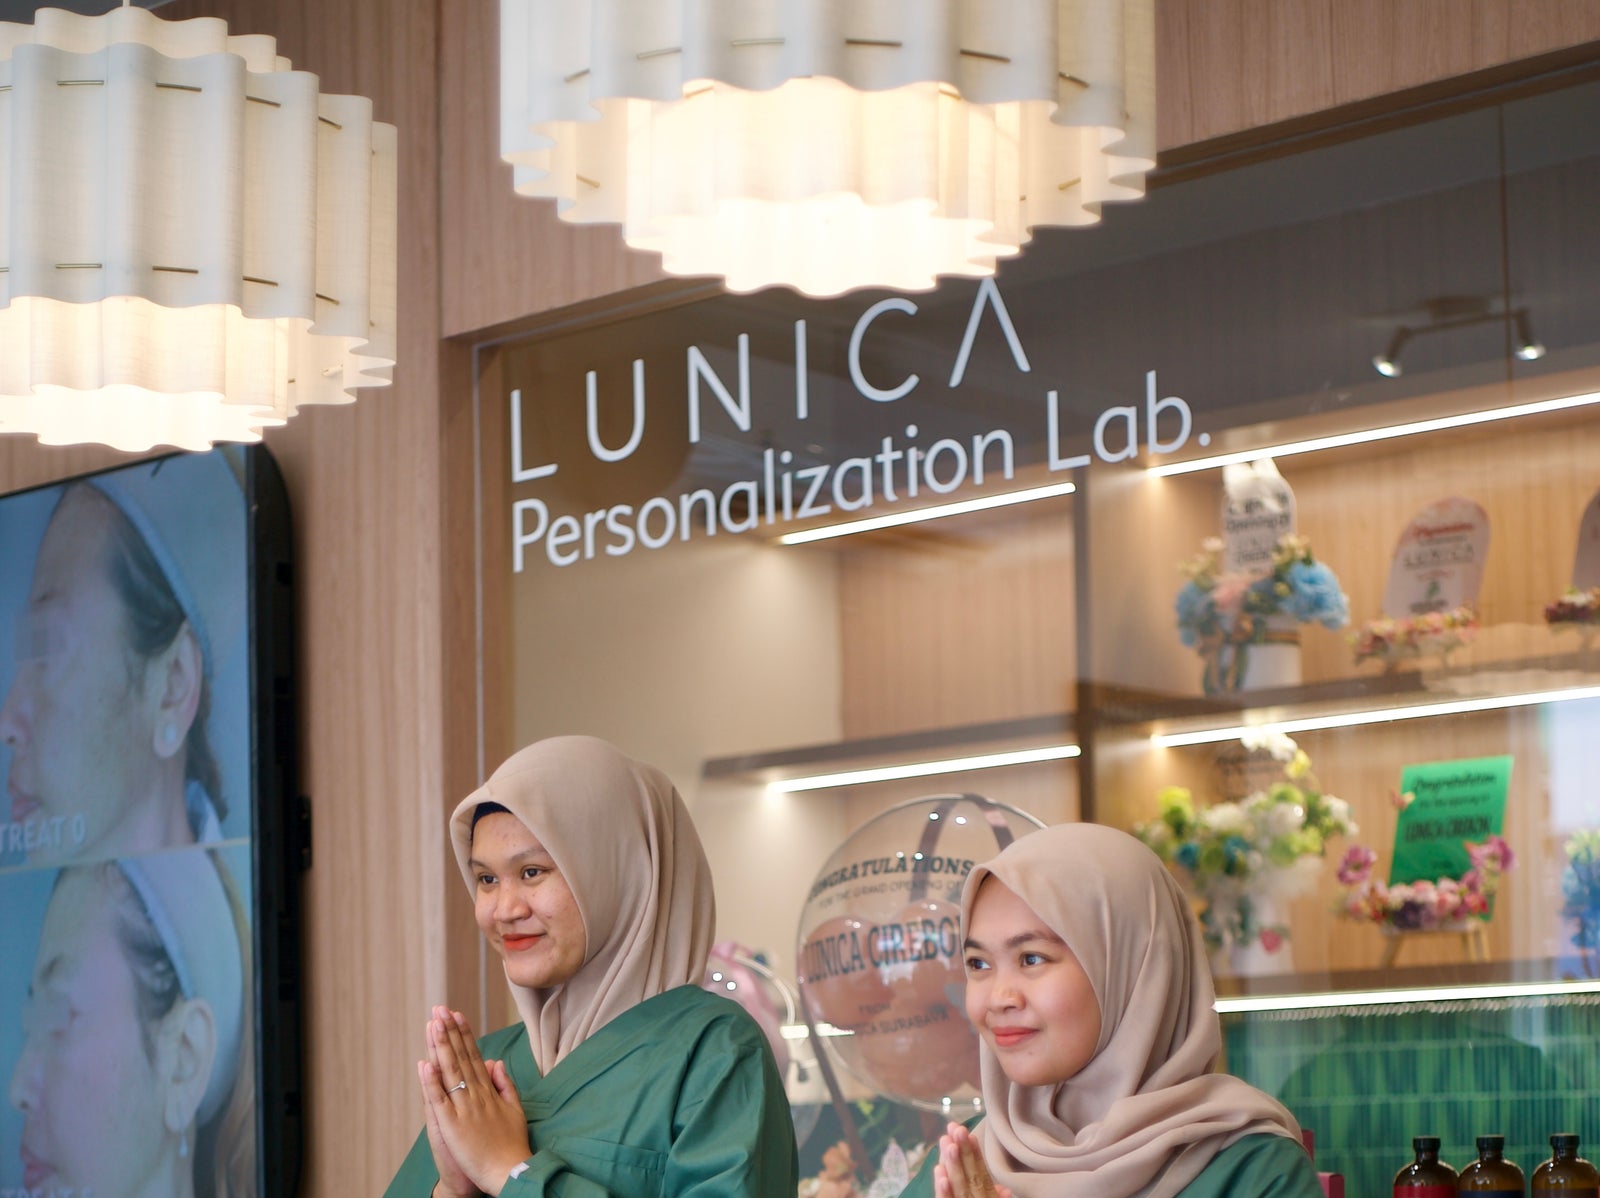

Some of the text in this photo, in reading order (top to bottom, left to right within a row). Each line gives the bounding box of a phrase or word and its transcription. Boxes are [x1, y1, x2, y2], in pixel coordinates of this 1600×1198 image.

[510, 277, 1031, 484] LUNICA
[512, 370, 1211, 573] Personalization Lab.
